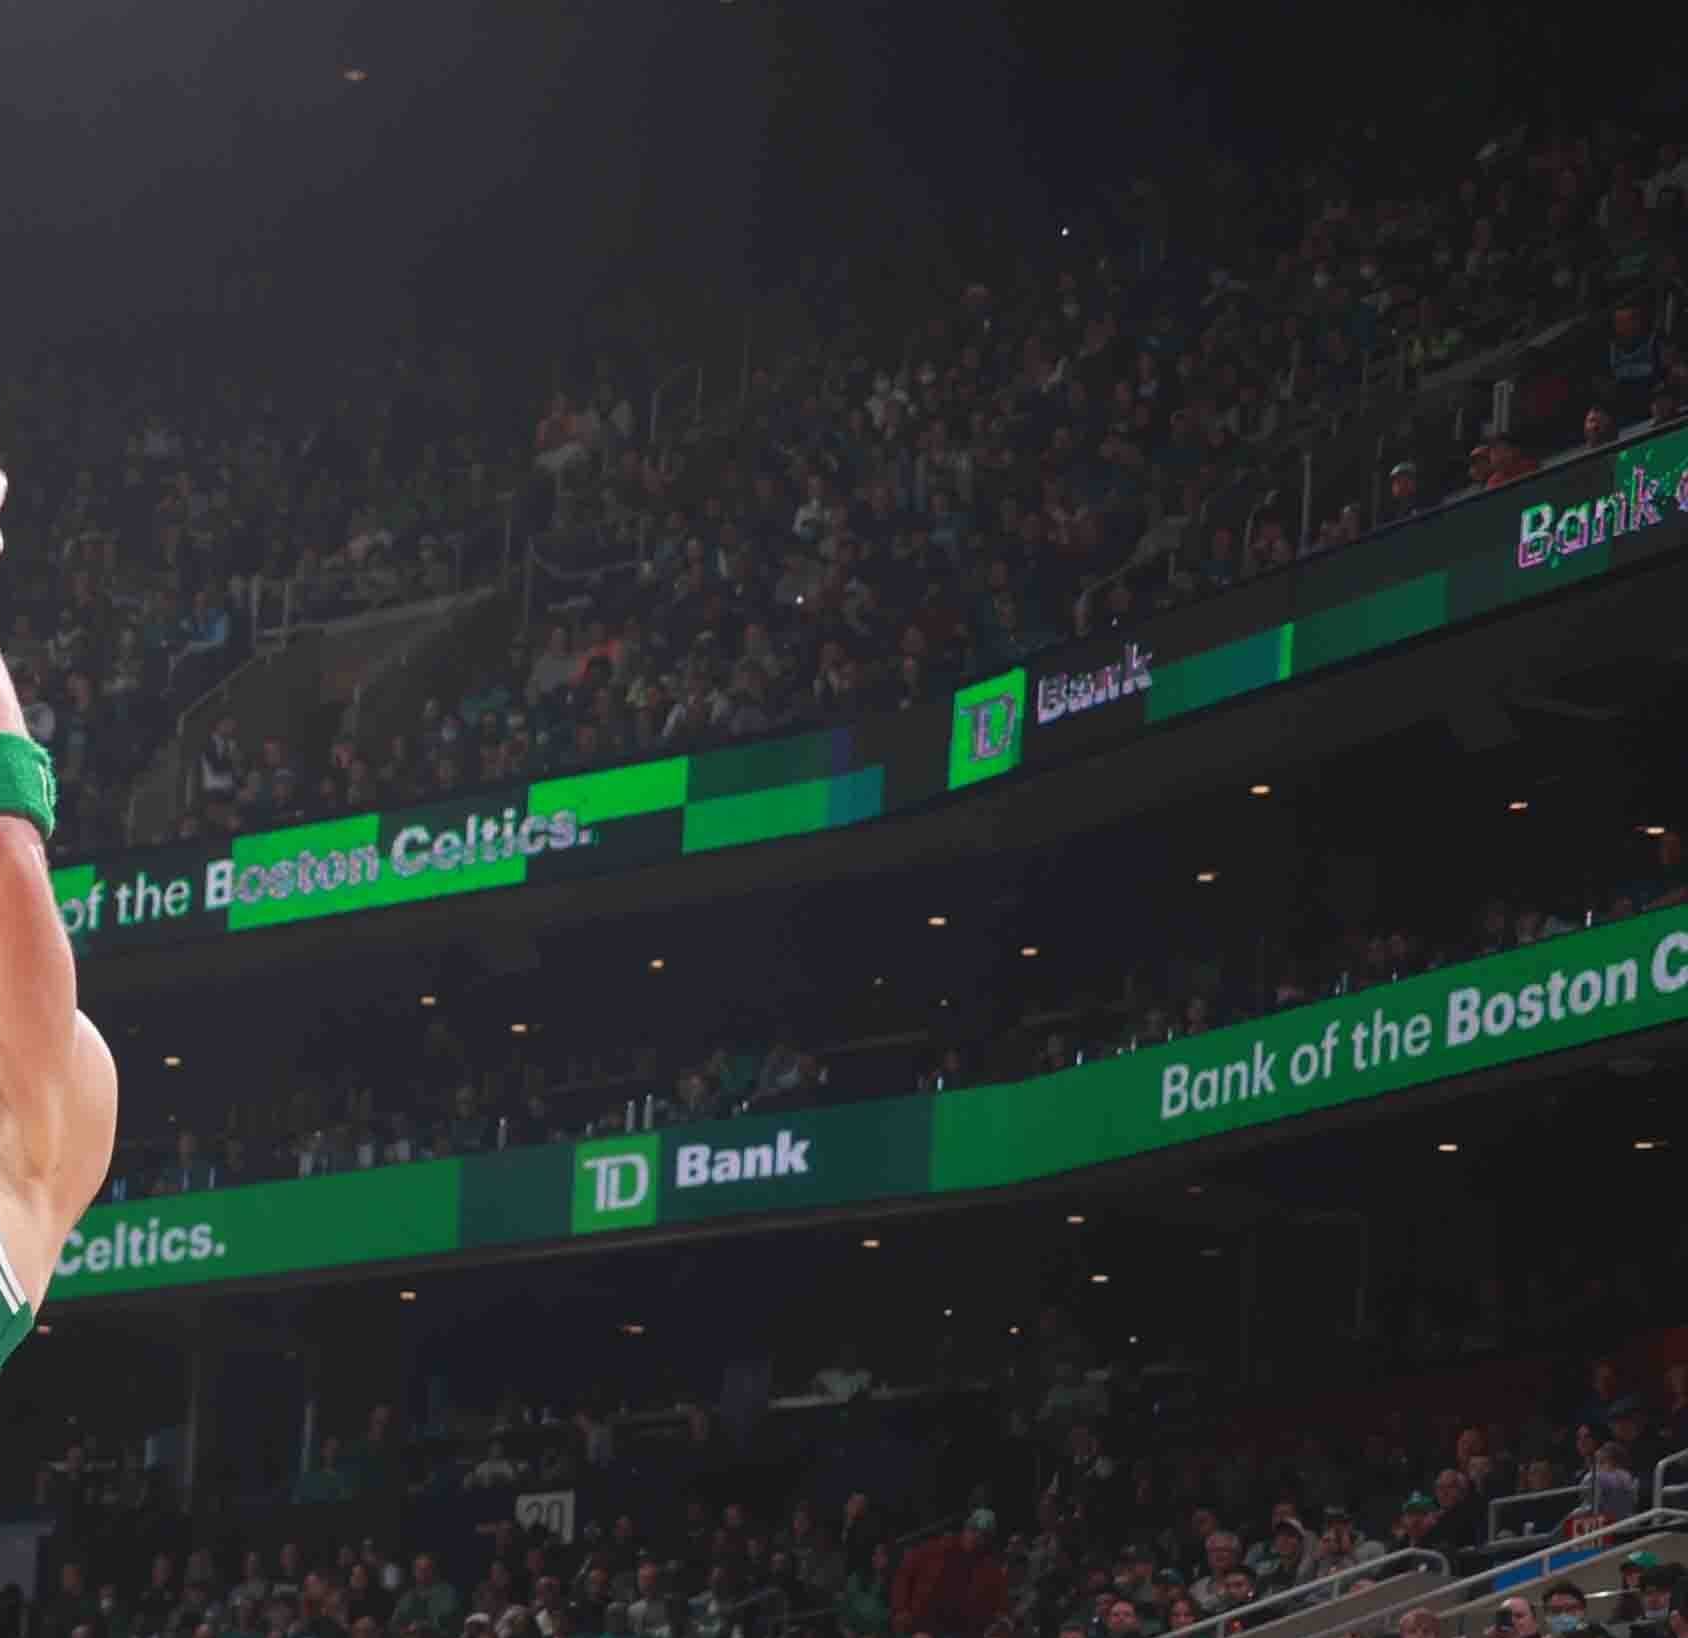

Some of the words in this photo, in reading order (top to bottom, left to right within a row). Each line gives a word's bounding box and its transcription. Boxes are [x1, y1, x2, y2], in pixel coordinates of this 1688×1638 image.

[1518, 464, 1663, 568] Bank
[1036, 643, 1153, 724] Bank
[61, 881, 104, 932] of
[115, 872, 192, 926] the
[204, 842, 379, 911] Boston
[389, 808, 592, 877] Celtics.
[1160, 1042, 1276, 1121] Bank
[1288, 1027, 1341, 1087] of
[1352, 1009, 1433, 1069] the
[1445, 954, 1638, 1048] Boston
[583, 1152, 649, 1214] TD
[675, 1131, 810, 1189] Bank
[55, 1219, 227, 1278] Celtics.
